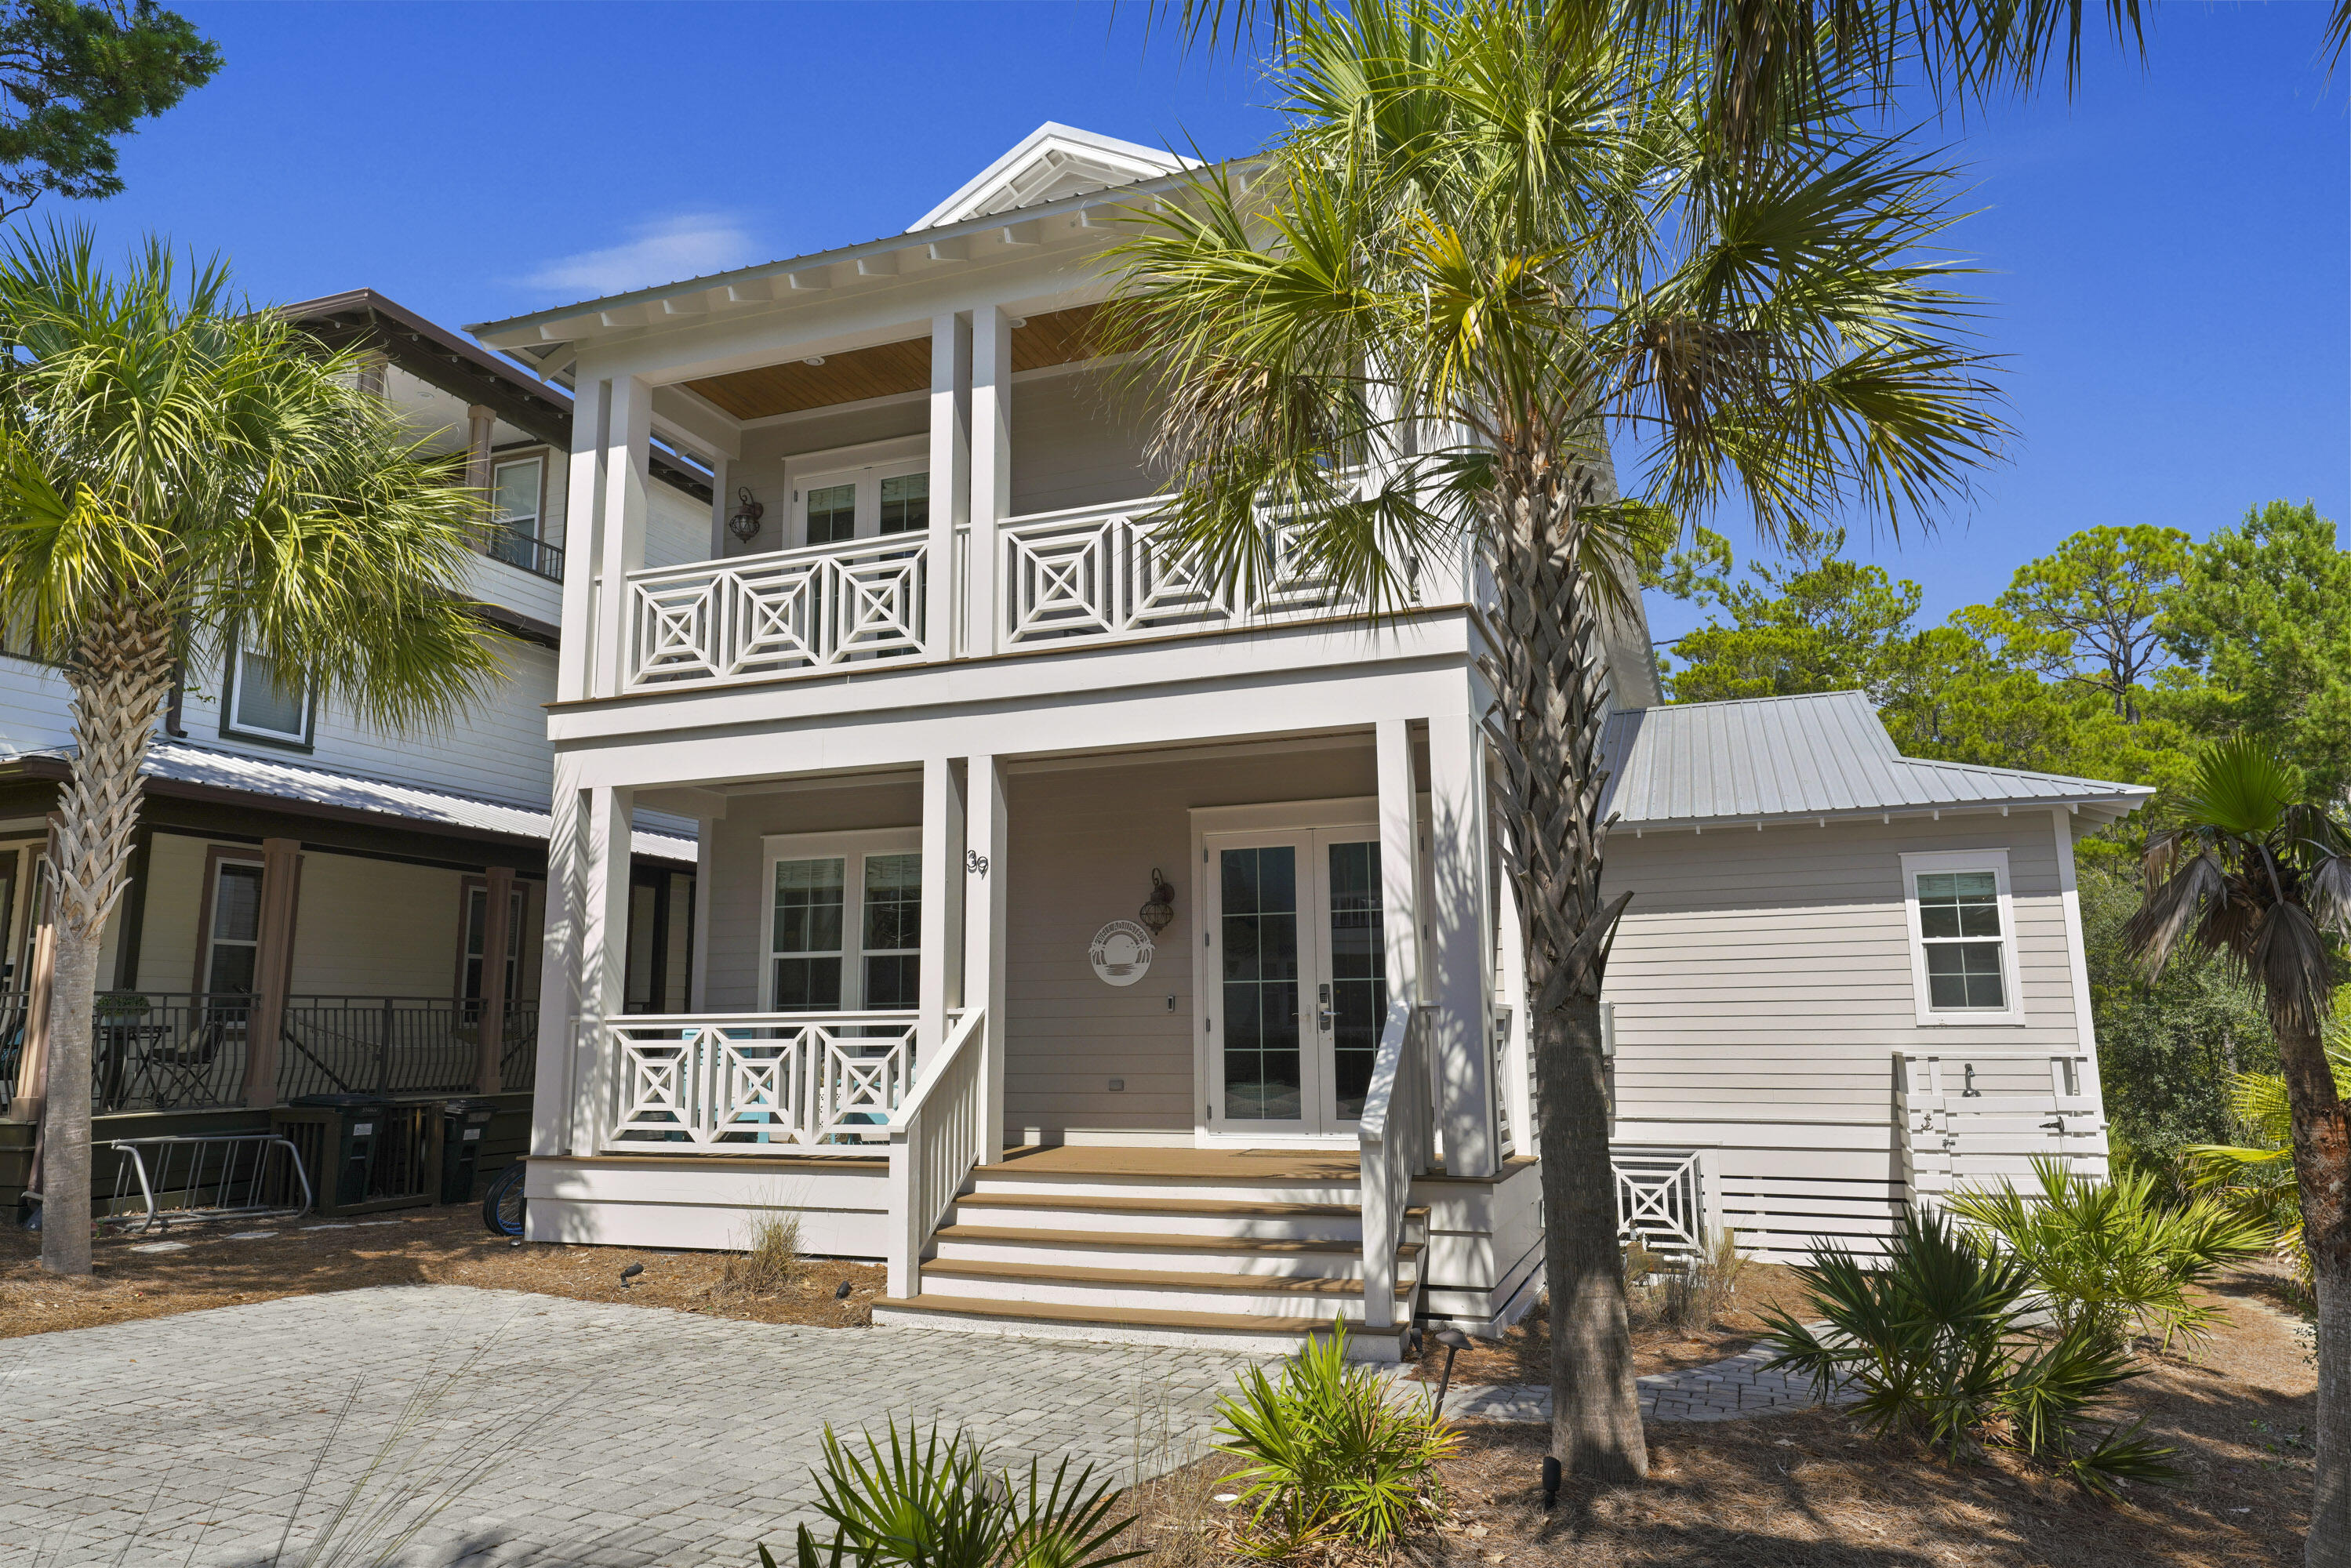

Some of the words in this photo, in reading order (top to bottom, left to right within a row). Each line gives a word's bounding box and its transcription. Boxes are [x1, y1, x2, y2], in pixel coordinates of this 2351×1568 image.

[966, 850, 988, 875] 39
[1096, 924, 1114, 941] WELL
[1114, 921, 1145, 940] ADJUSTED
